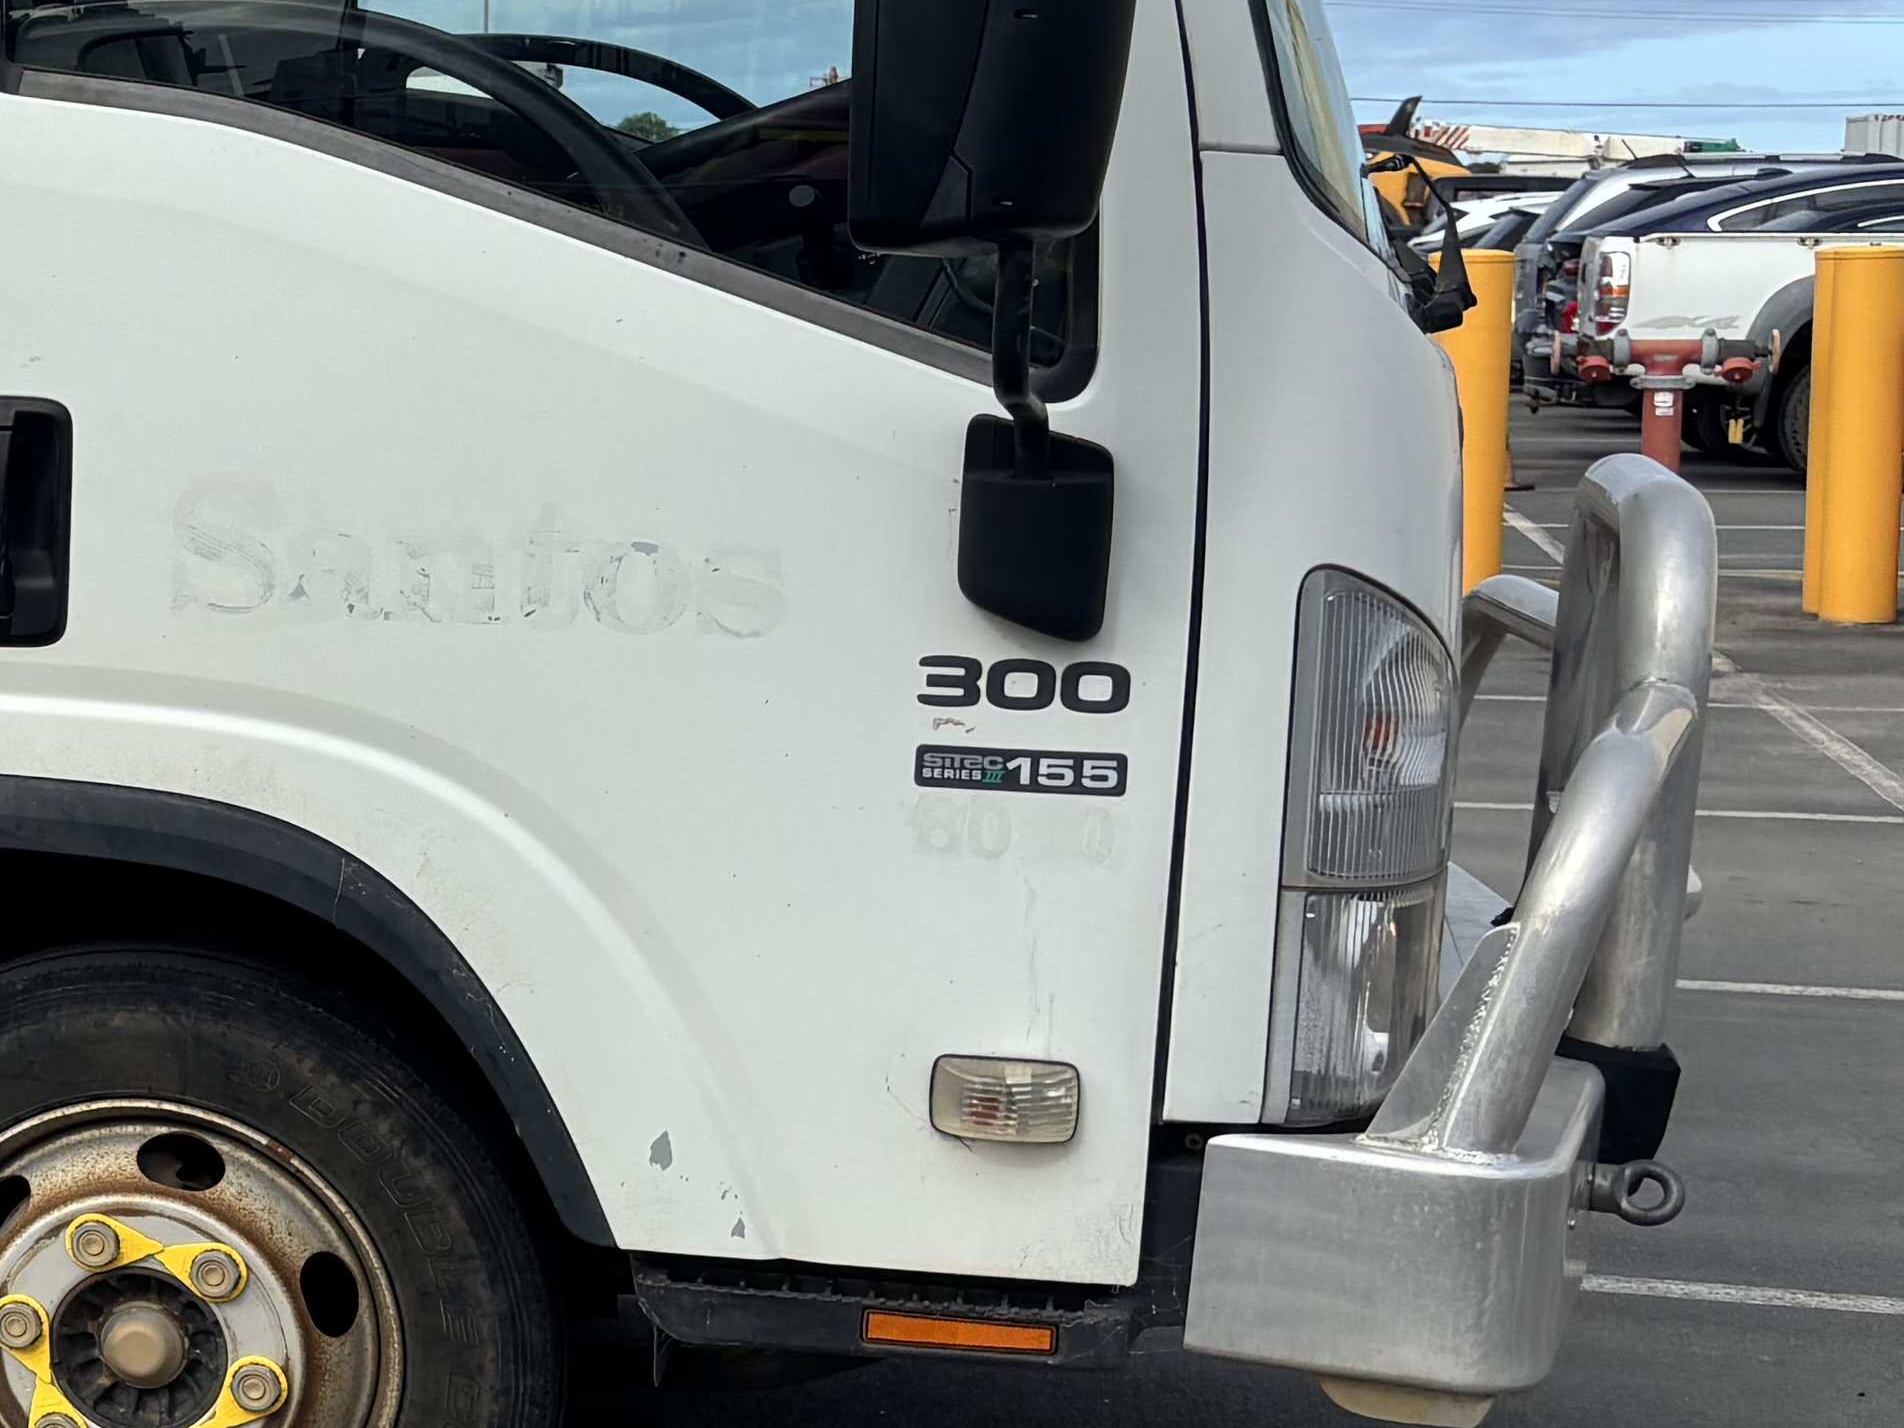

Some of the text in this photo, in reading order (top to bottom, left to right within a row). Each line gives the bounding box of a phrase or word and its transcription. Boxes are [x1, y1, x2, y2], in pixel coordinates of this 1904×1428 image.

[171, 472, 790, 639] Santos
[917, 654, 1131, 714] 300
[922, 768, 1006, 783] SERIES III
[1006, 757, 1118, 789] 155
[288, 1084, 477, 1344] DOUBLE
